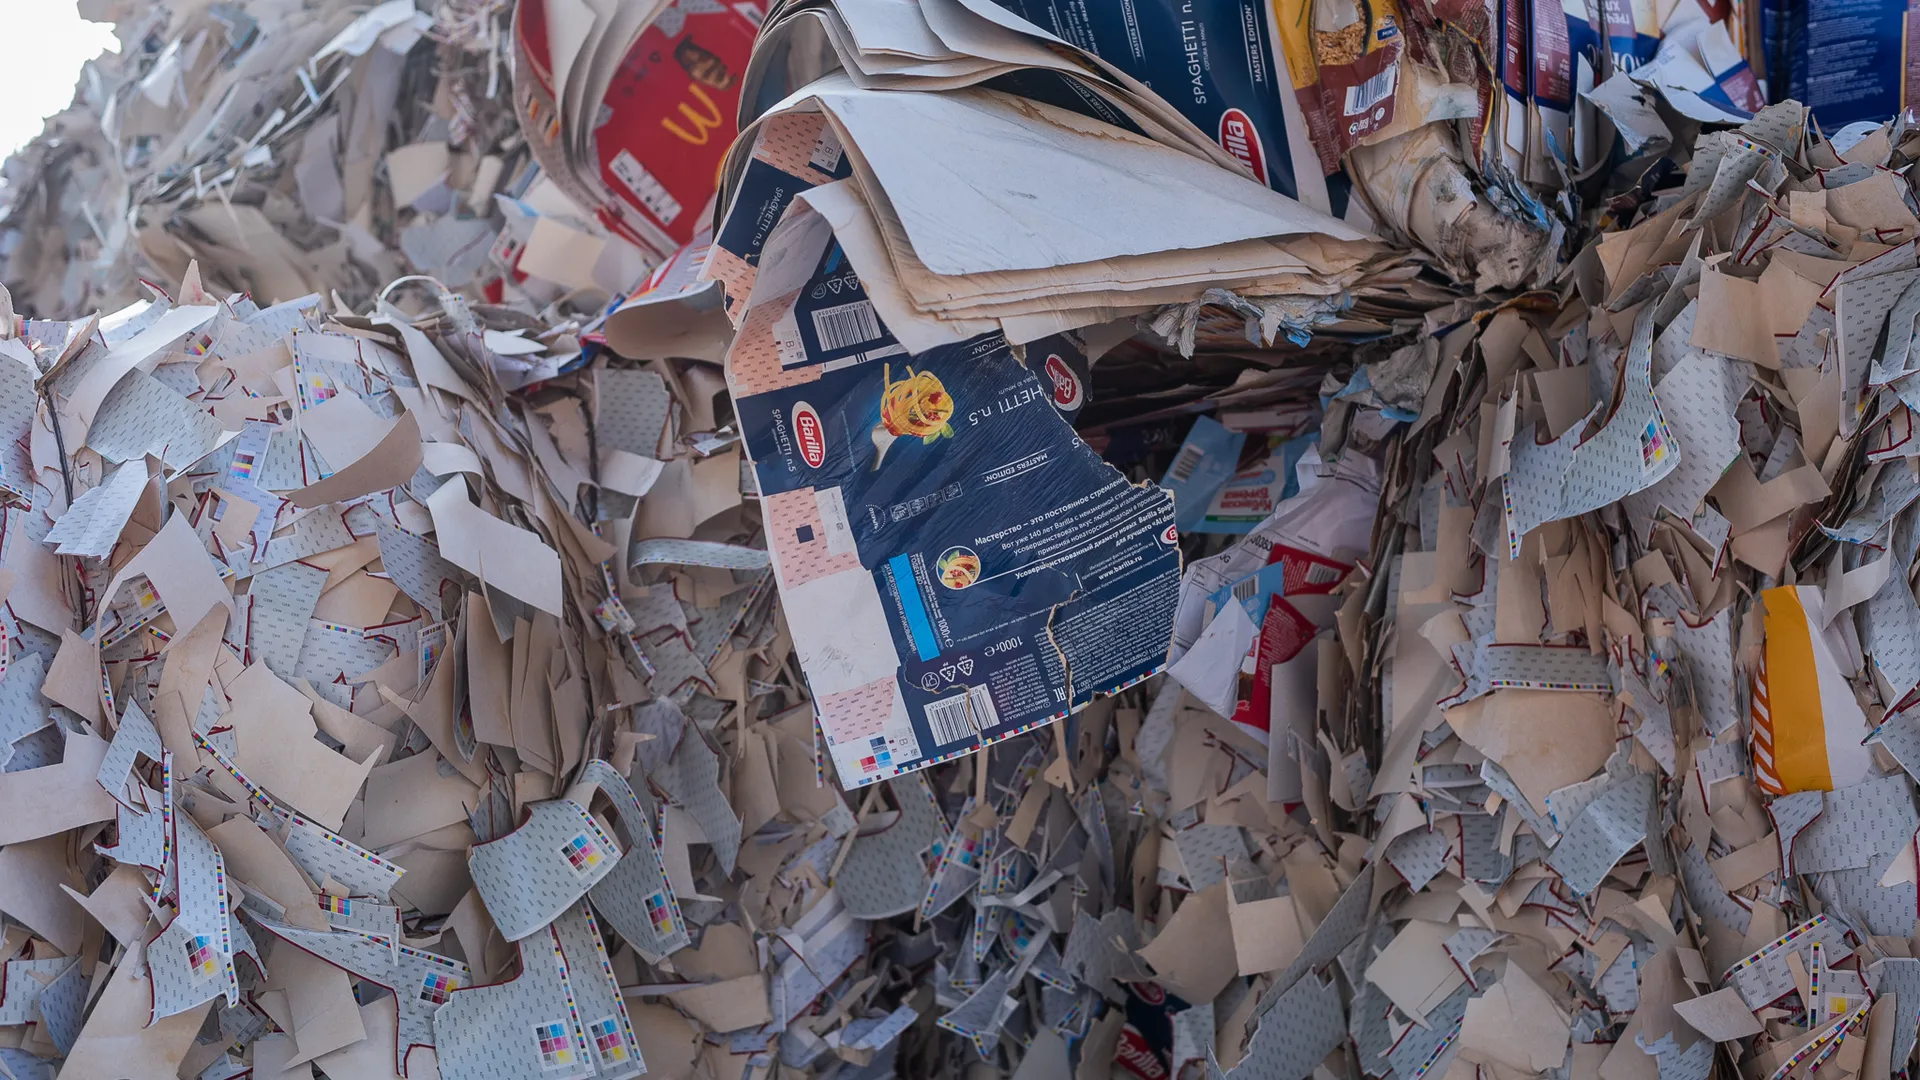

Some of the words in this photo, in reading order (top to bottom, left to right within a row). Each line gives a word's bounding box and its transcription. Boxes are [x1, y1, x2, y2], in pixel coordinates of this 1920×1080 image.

[1182, 0, 1193, 14] n.
[1129, 30, 1142, 58] MASTERS
[1181, 20, 1207, 104] SPAGHETTI
[1252, 44, 1263, 82] MASTERS
[761, 187, 784, 231] SPAGHETTI
[752, 232, 763, 247] n.5
[999, 384, 1043, 414] HETTI
[968, 406, 992, 426] n.5
[772, 408, 792, 457] SPAGHETTI
[786, 458, 797, 472] n.5
[799, 416, 820, 463] Barilla
[1016, 452, 1048, 471] MASTERS
[974, 522, 1022, 546] Мастерство
[1029, 514, 1043, 525] это
[1043, 495, 1089, 519] постоянное
[1001, 540, 1014, 550] Вот
[1014, 535, 1029, 546] уже
[1028, 529, 1042, 539] 140
[1041, 524, 1054, 534] лет
[1053, 516, 1074, 529] Barilla
[1078, 496, 1114, 518] неизменной
[1013, 523, 1079, 556] усовершенствовать
[1078, 517, 1093, 529] вкус
[1092, 503, 1119, 522] любимой
[1036, 537, 1070, 556] применяя
[1069, 519, 1109, 542] новаторские
[1108, 506, 1133, 524] подходы
[1136, 488, 1165, 508] производ
[1093, 529, 1119, 549] диаметр
[1118, 520, 1137, 534] новых
[1137, 508, 1157, 524] Barilla
[1114, 536, 1127, 547] для
[1125, 523, 1152, 541] лучшего
[883, 563, 891, 575] ДАТА
[909, 554, 920, 575] ГОДЕН
[915, 574, 923, 584] ДО
[1097, 555, 1142, 580] www.barilla.ru
[936, 617, 951, 639] 1000г
[1148, 639, 1170, 653] AGHETTI
